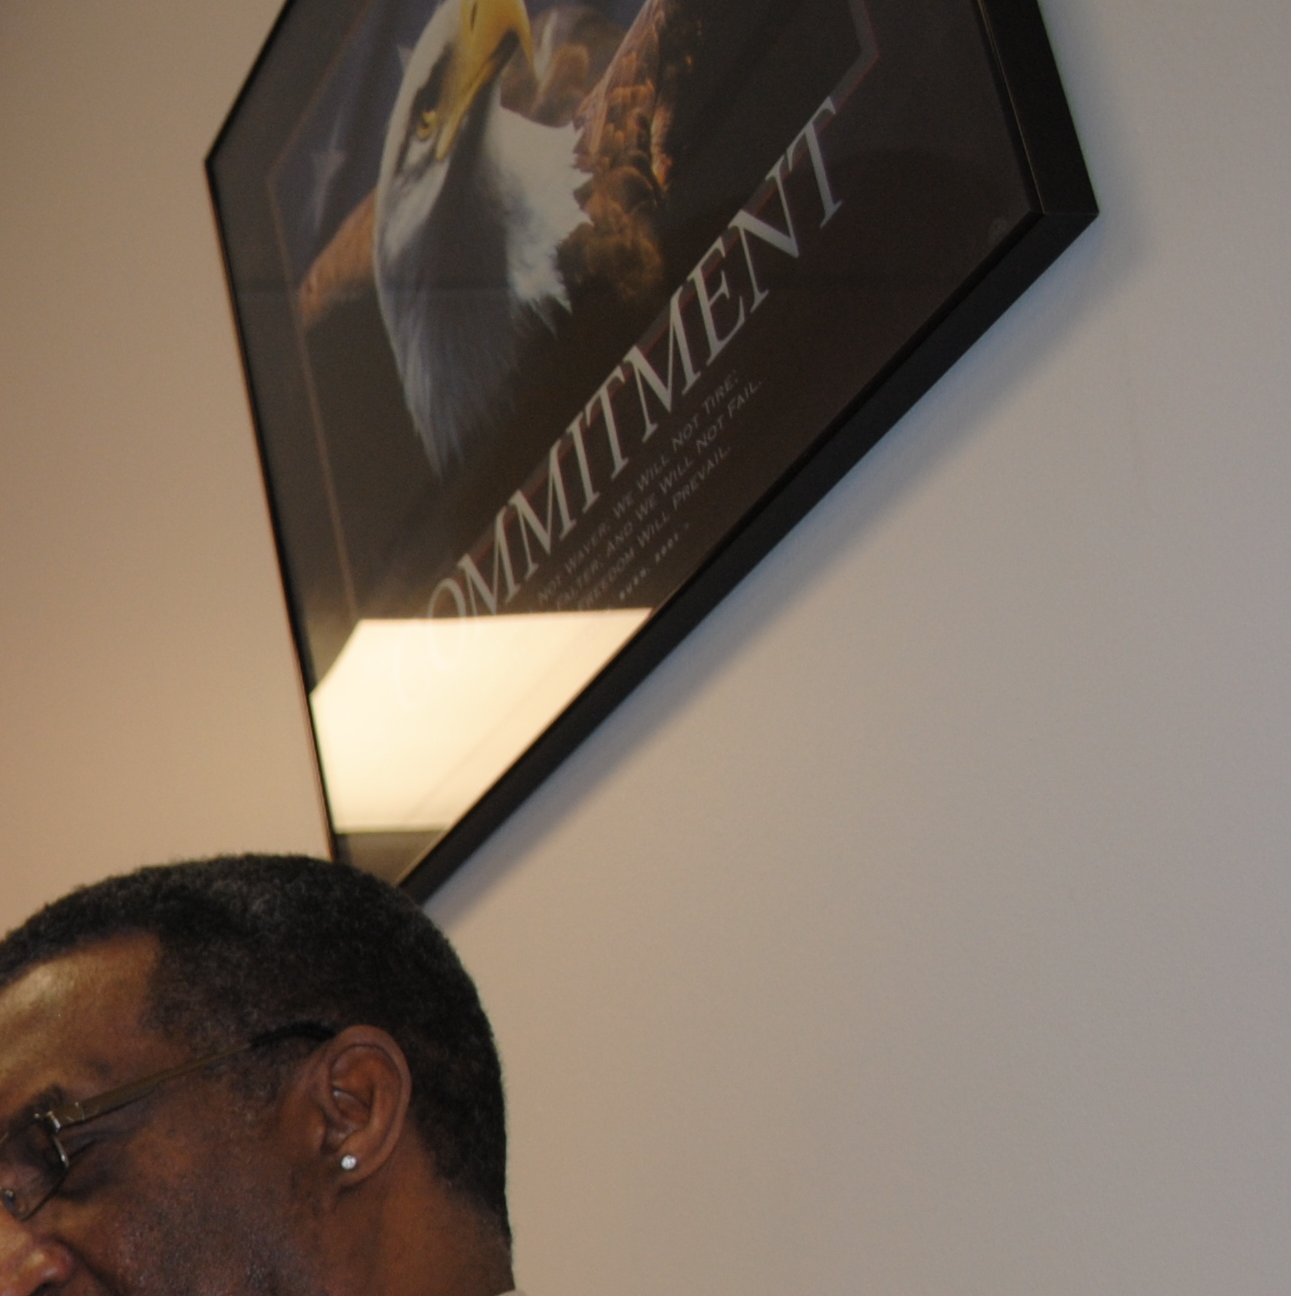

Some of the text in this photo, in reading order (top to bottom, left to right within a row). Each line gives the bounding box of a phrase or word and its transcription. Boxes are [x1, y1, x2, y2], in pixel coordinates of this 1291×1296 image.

[393, 97, 839, 710] OMMITMENT
[606, 521, 632, 556] AND
[635, 493, 656, 520] WE
[659, 457, 692, 493] WILL
[695, 414, 723, 453] NOT
[727, 381, 761, 418] FAIL.
[612, 491, 633, 518] WE
[636, 454, 669, 491] WILL
[671, 413, 698, 451] NOT
[637, 511, 670, 547] WILL
